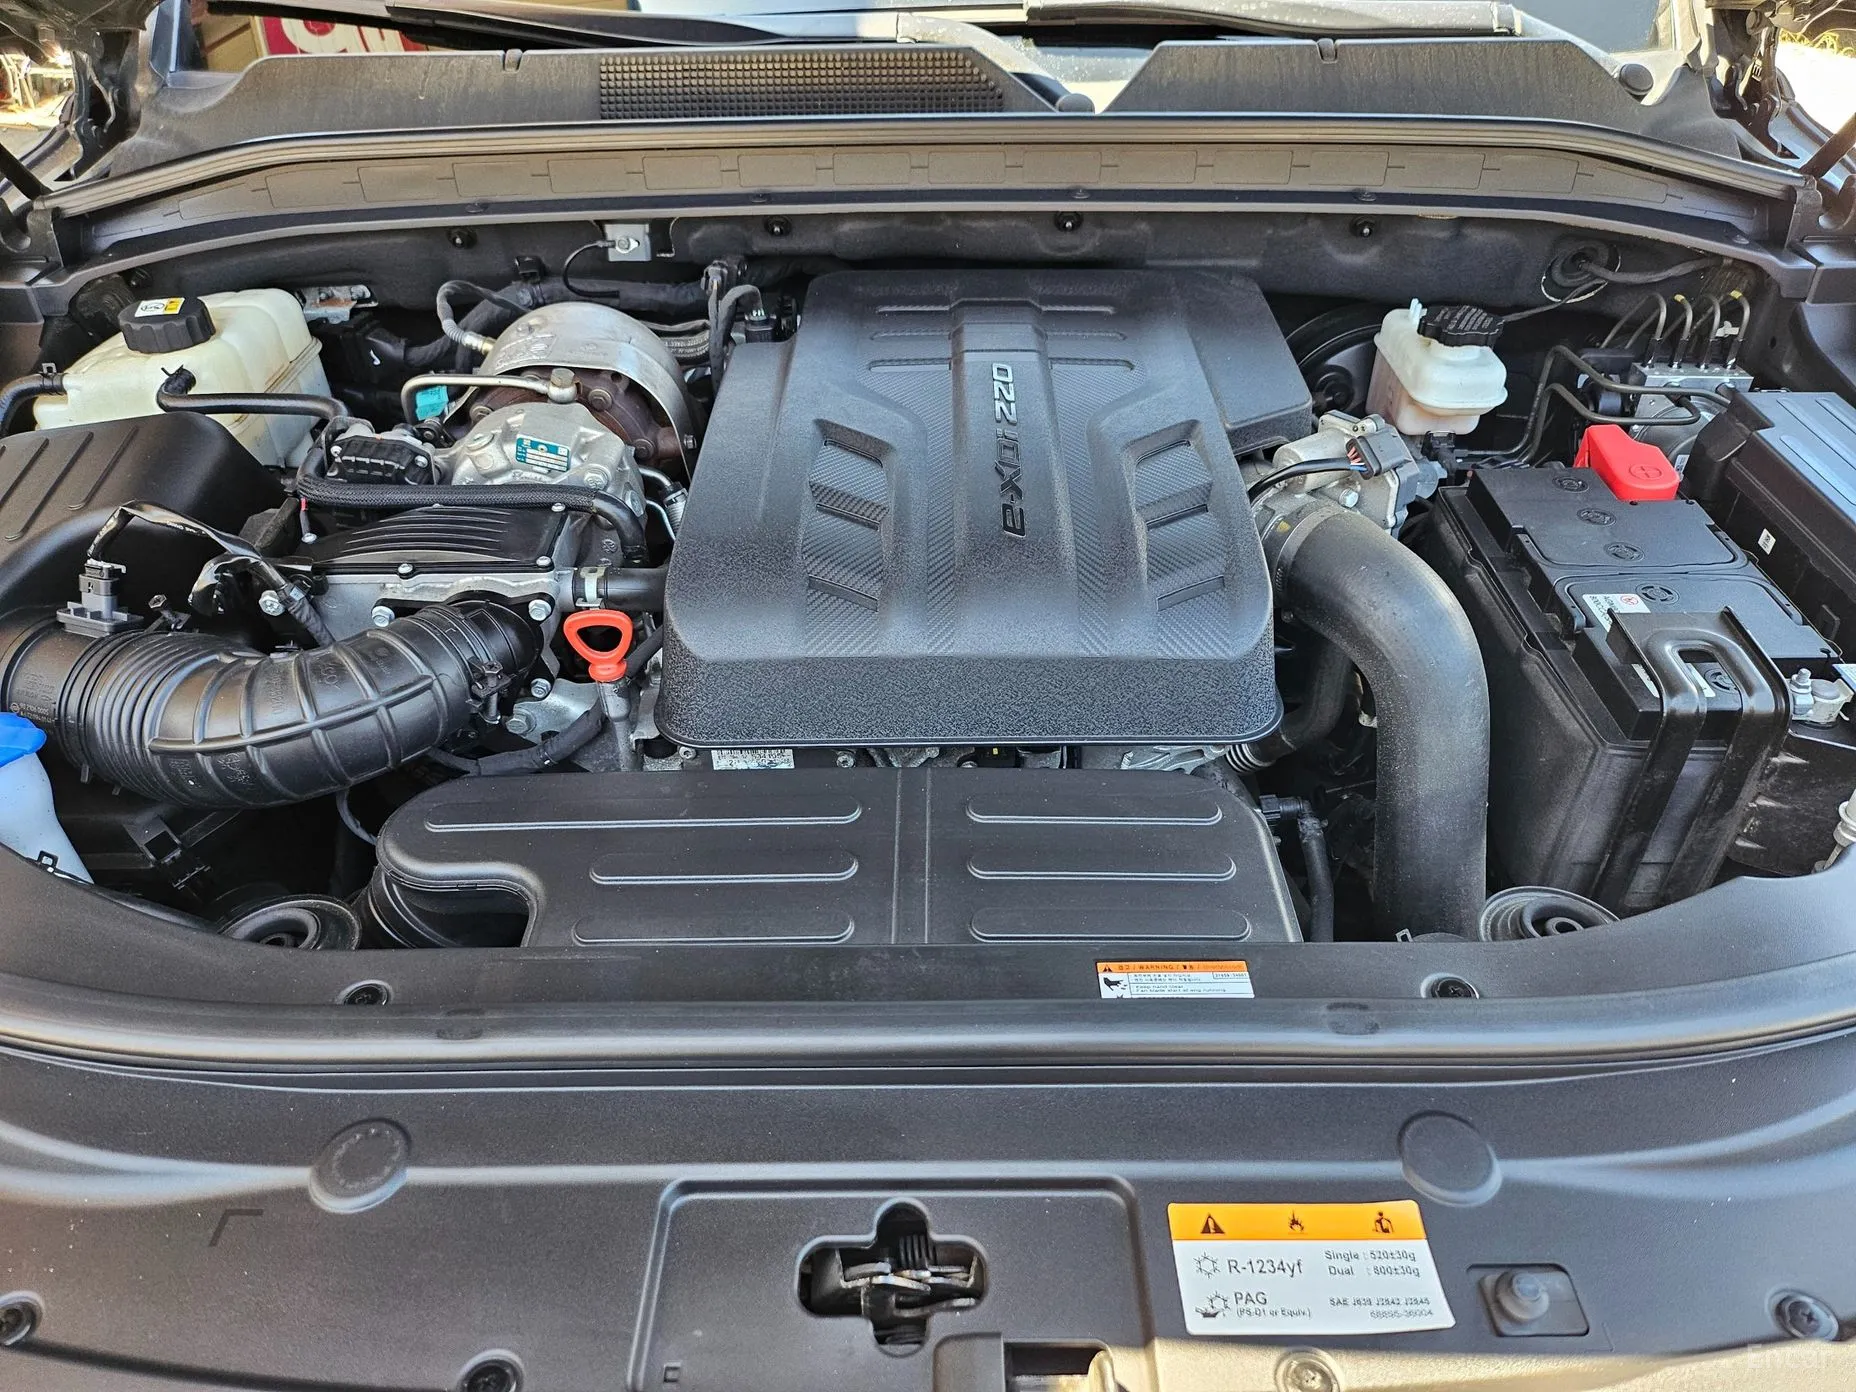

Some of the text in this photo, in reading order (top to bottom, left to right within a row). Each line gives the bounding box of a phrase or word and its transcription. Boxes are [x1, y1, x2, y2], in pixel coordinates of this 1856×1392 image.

[991, 362, 1018, 425] 220
[1324, 1249, 1360, 1262] Single
[1227, 1258, 1303, 1277] R-1234yf
[1328, 1265, 1355, 1276] Dual
[1234, 1291, 1267, 1305] PAG
[1329, 1297, 1349, 1306] SAE
[1269, 1309, 1278, 1317] or
